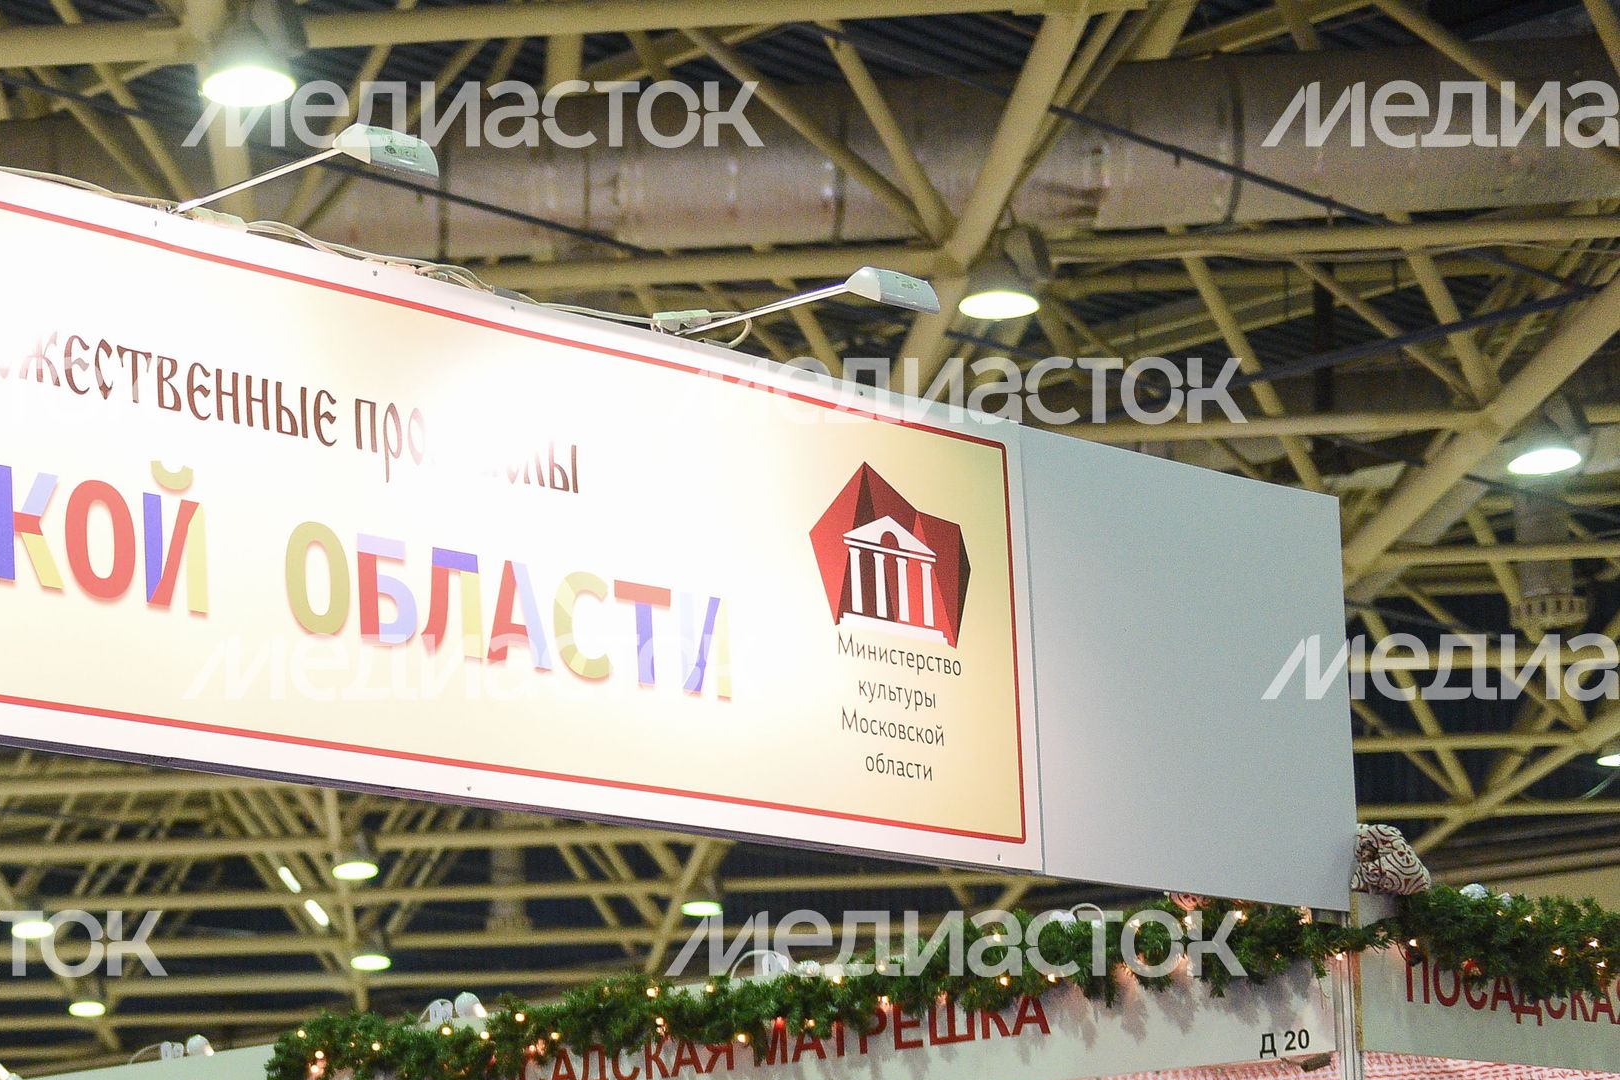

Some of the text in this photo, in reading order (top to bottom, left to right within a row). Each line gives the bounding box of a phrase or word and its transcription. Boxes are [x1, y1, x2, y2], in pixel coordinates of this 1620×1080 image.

[284, 521, 732, 701] ОБЛАСТИ
[837, 631, 962, 677] Министерство
[858, 679, 937, 712] культуры
[841, 706, 945, 747] Московской
[865, 752, 934, 782] области
[1259, 1028, 1310, 1059] Д 20
